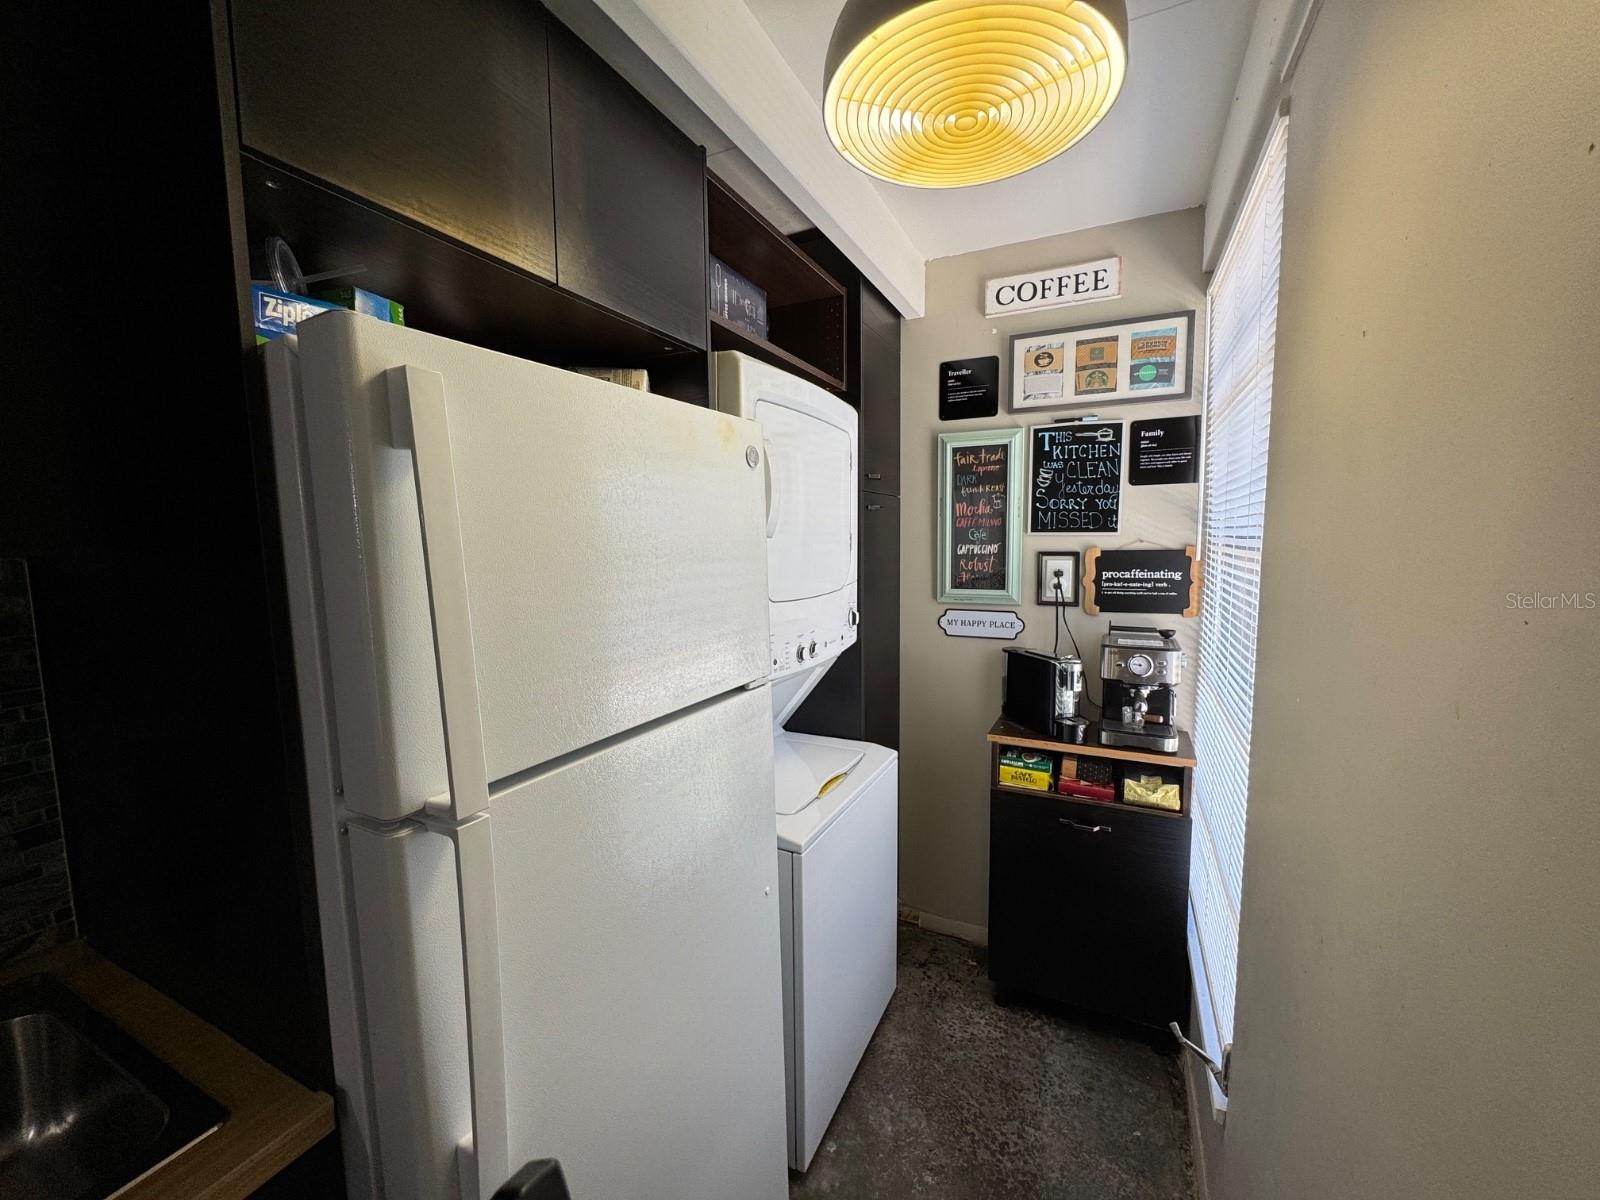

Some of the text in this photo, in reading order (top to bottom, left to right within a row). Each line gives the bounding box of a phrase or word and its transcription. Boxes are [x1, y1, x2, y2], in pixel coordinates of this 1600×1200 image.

[995, 268, 1110, 306] COFFEE
[1038, 431, 1073, 451] THIS
[1140, 429, 1165, 438] Family
[1052, 442, 1121, 460] KITCHEN
[1066, 458, 1120, 479] CLEAN
[1036, 488, 1118, 510] SORRY YOU
[1037, 511, 1119, 530] MISSED it
[957, 542, 1002, 555] CAPPUCCINO
[1102, 568, 1183, 581] procaffeinating
[946, 618, 1016, 629] MY HAPPY PLACE
